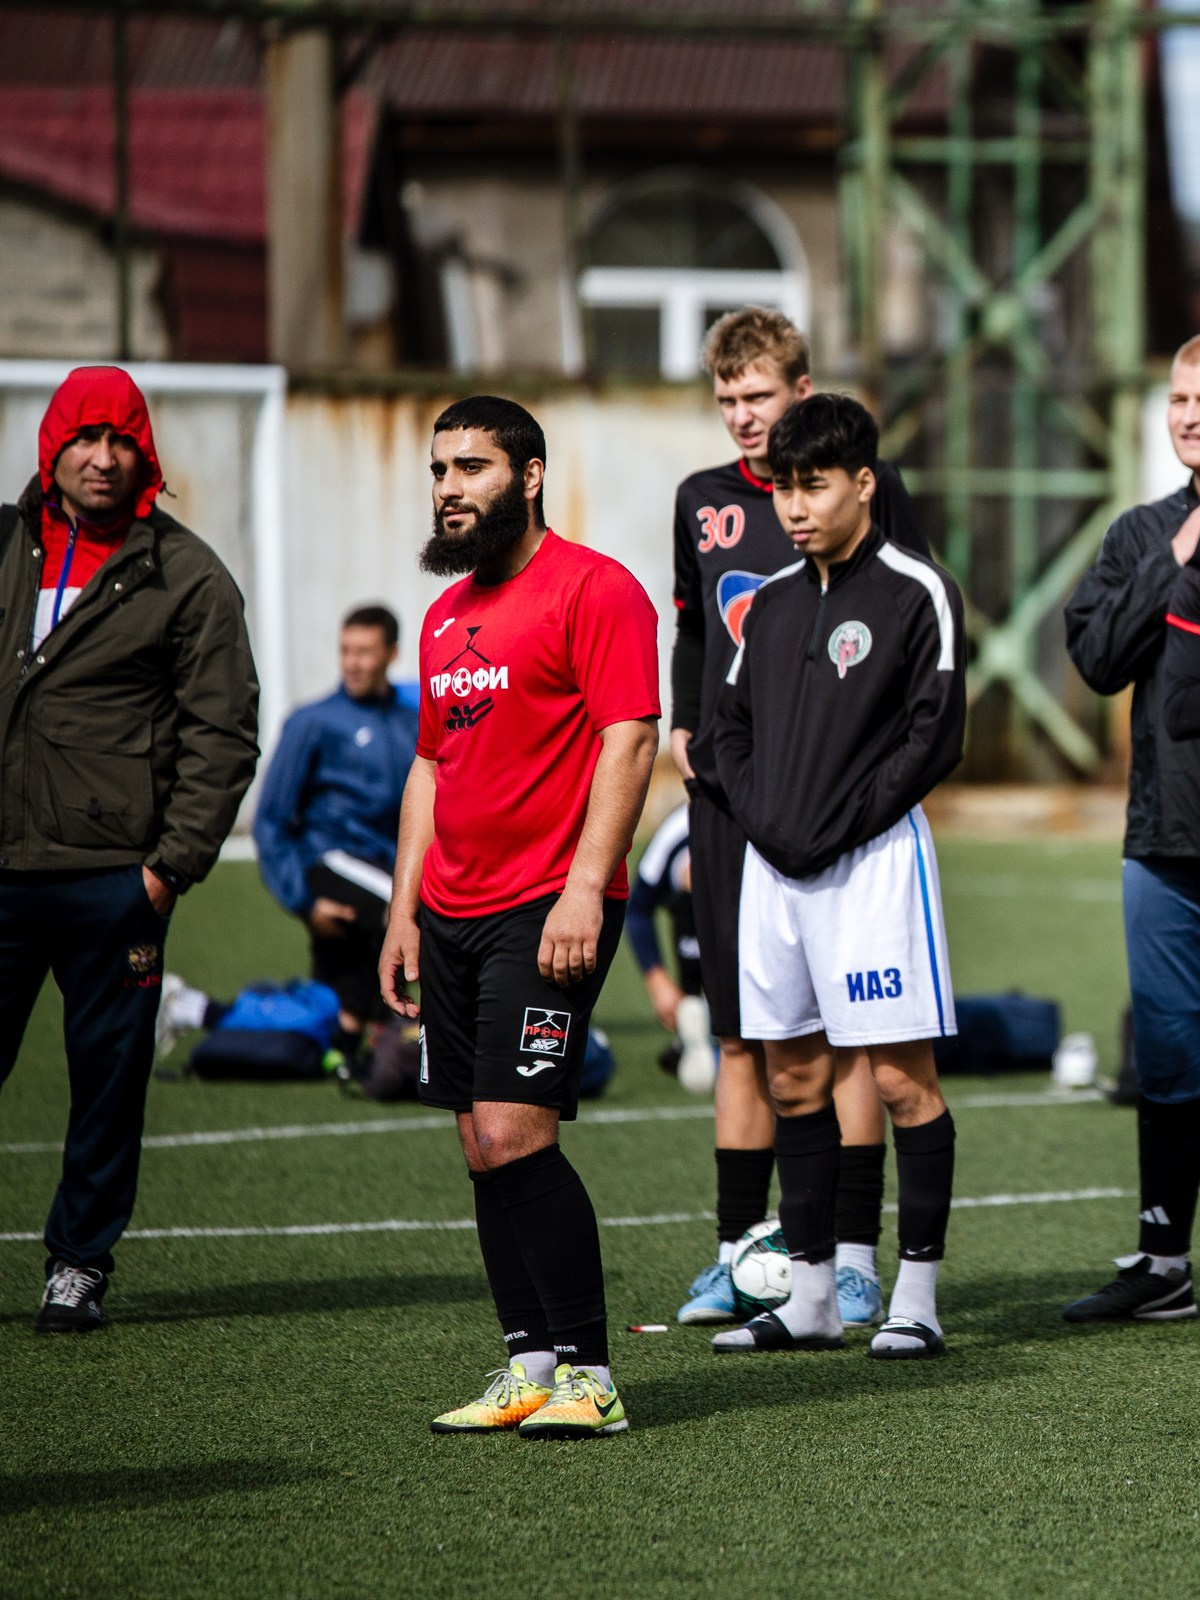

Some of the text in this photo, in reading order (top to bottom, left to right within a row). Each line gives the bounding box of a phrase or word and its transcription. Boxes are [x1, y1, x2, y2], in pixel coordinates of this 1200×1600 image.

[696, 504, 746, 553] 30
[430, 666, 509, 699] ПРОФИ
[846, 967, 903, 1003] ИАЗ
